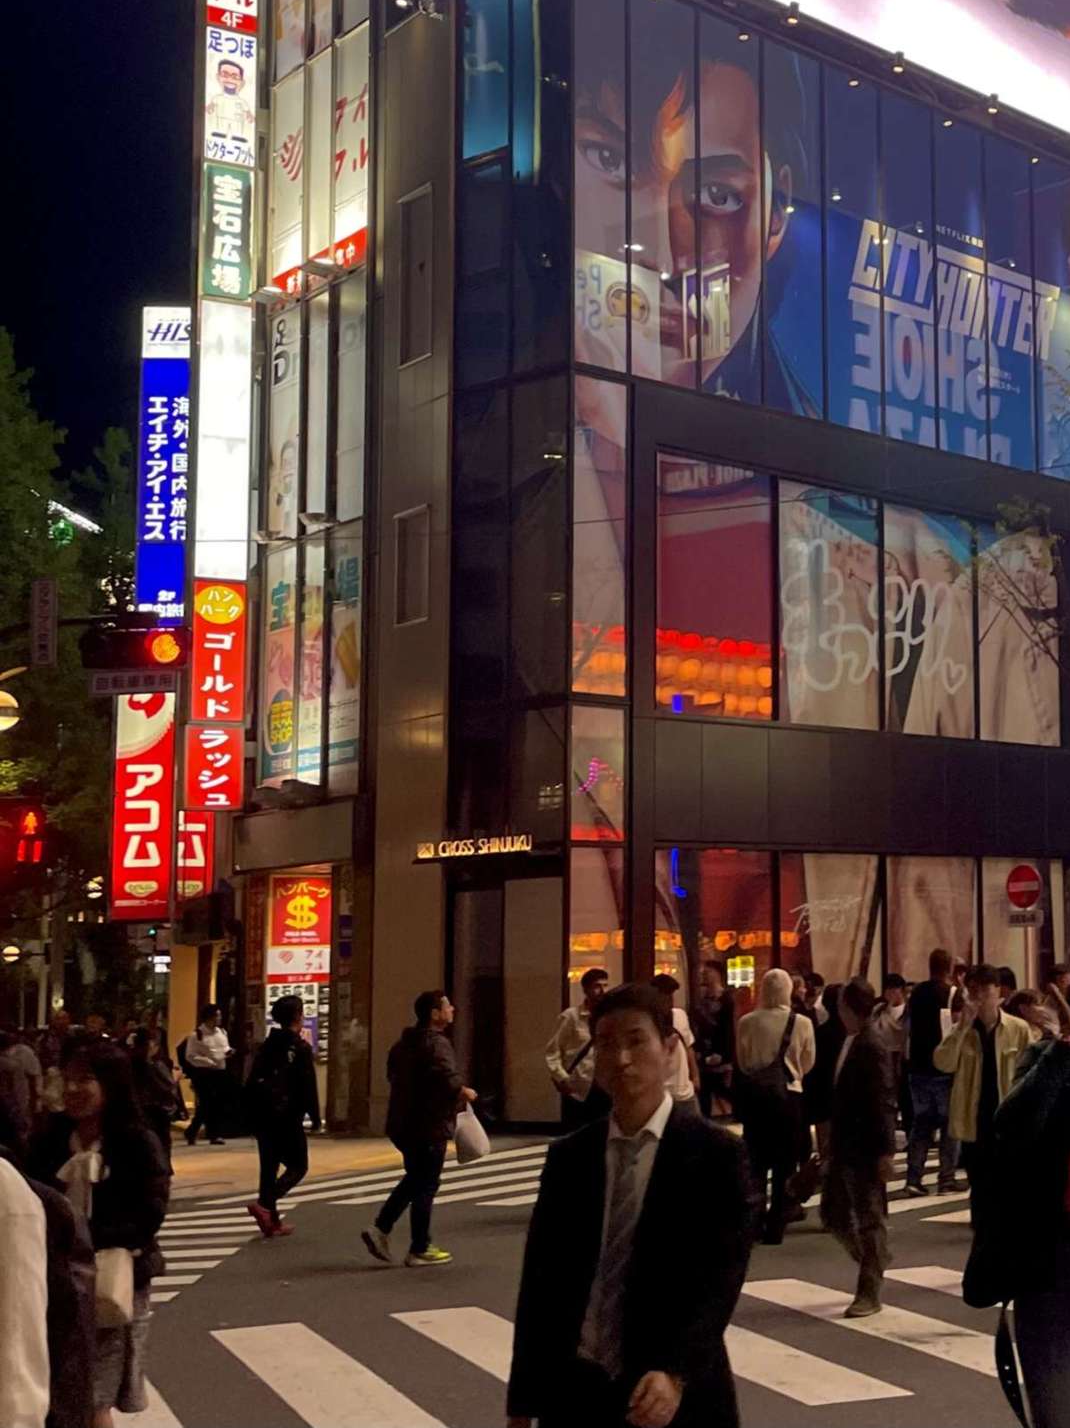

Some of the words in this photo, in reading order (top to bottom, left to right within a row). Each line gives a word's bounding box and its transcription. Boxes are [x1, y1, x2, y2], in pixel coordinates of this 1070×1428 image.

[208, 29, 255, 59] 足つぼ
[220, 12, 244, 28] 4F
[210, 174, 243, 295] 宝石広場
[850, 218, 937, 308] CITY
[147, 322, 191, 342] HIS
[935, 257, 1061, 361] HUNTER
[143, 396, 169, 541] エイチ・アイ・エス
[169, 396, 190, 542] 海外・国内旅行
[200, 631, 237, 719] ゴールド
[197, 729, 232, 807] ラッシュ
[122, 763, 164, 869] アコム
[438, 839, 475, 857] CROSS
